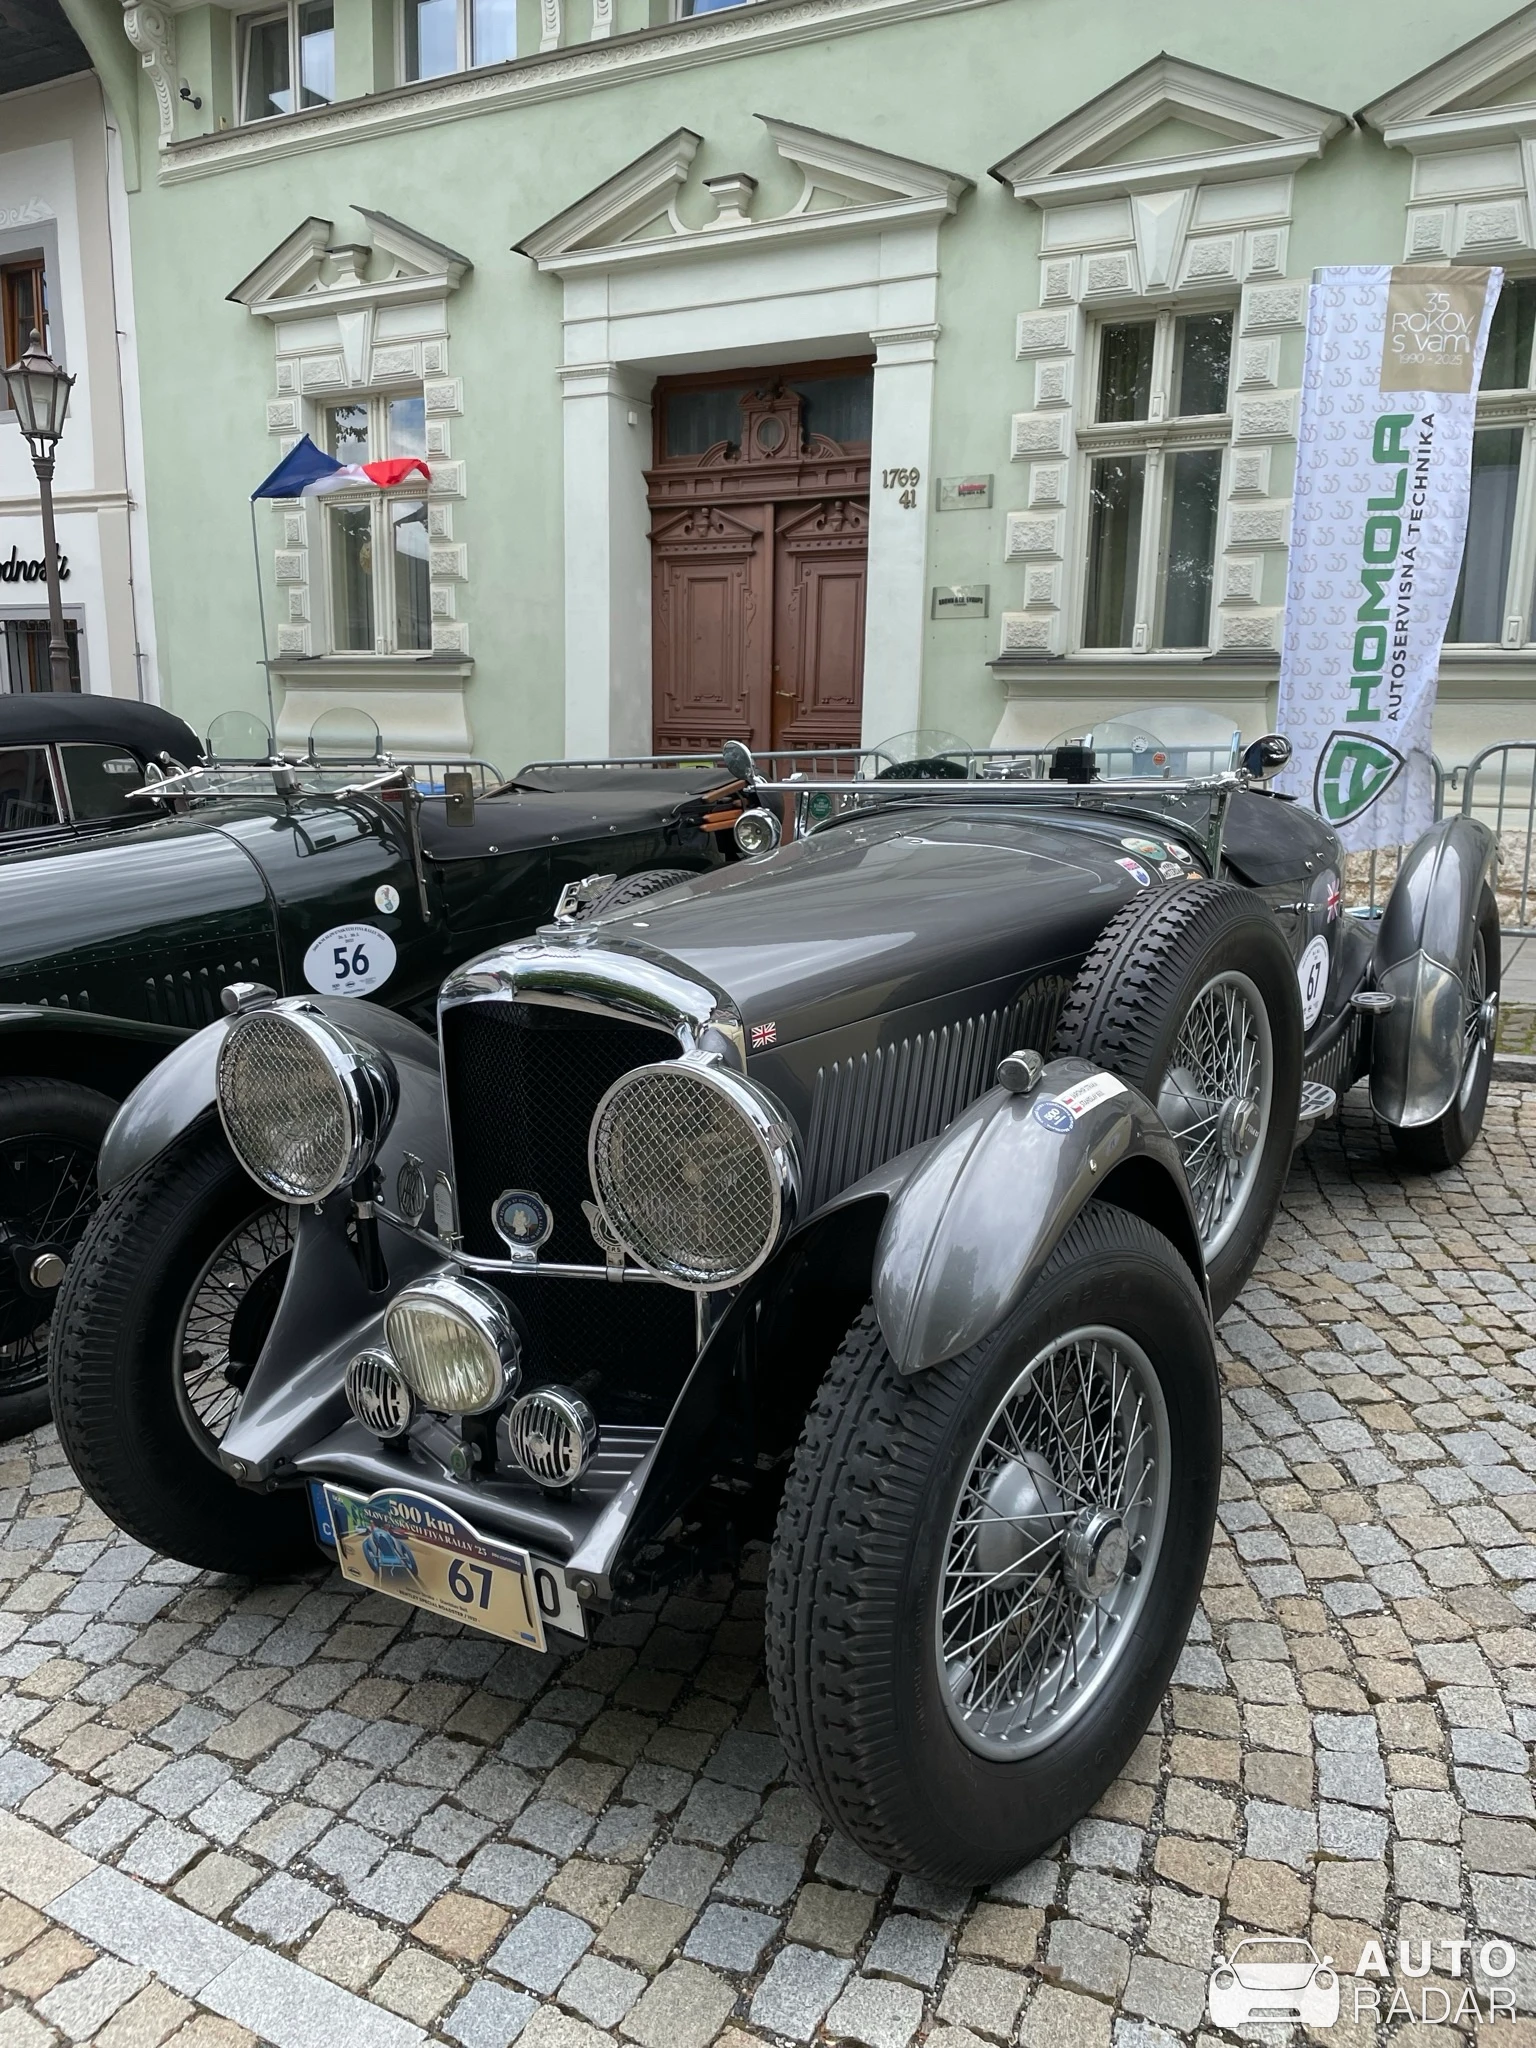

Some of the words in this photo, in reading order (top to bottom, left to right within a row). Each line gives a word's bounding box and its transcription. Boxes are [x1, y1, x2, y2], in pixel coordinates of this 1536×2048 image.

[1424, 293, 1450, 312] 35
[1392, 312, 1476, 332] ROKOV
[1400, 354, 1424, 364] 1990
[1434, 354, 1463, 365] 2025
[882, 467, 920, 488] 1769
[899, 490, 917, 509] 41
[1346, 414, 1414, 722] HOMOLA
[1388, 546, 1417, 721] AUTOSERVISNÁ
[1408, 414, 1435, 536] TECHNIKA
[334, 942, 369, 979] 56
[1307, 961, 1321, 1002] 67
[594, 1233, 621, 1252] DRIVERS
[388, 1500, 421, 1524] 500
[424, 1511, 455, 1536] km
[445, 1536, 473, 1552] RALLY
[448, 1558, 492, 1610] 67
